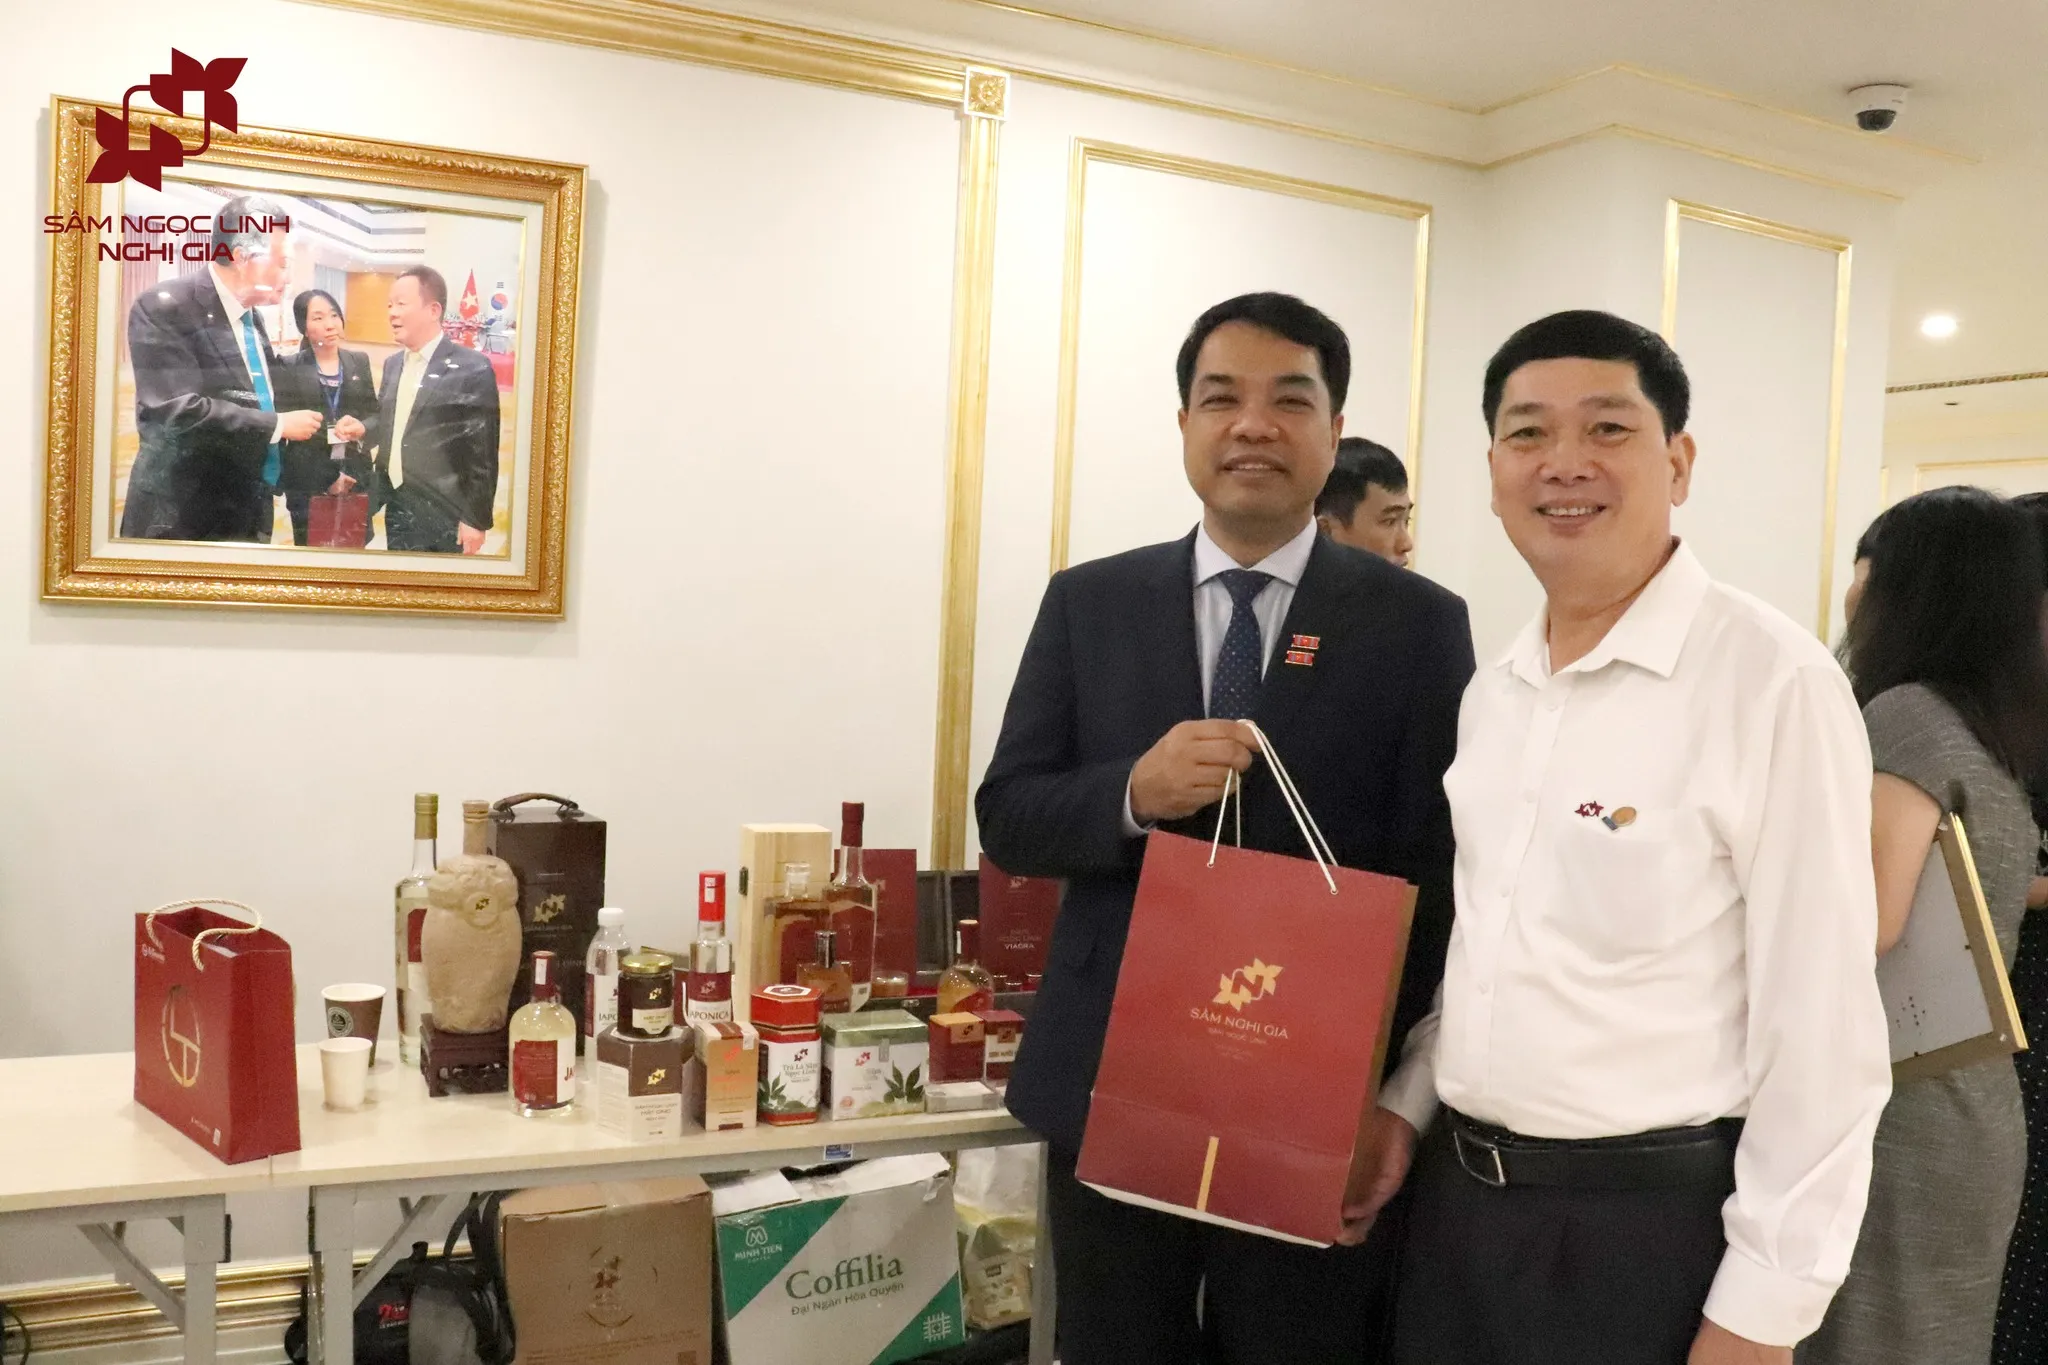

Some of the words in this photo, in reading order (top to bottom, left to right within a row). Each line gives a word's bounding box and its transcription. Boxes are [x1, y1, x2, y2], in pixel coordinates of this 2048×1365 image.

[1190, 1007, 1222, 1024] SÂM
[1224, 1016, 1261, 1034] NGHỊ
[1263, 1024, 1289, 1040] GIA
[733, 1248, 760, 1261] MINH
[785, 1253, 903, 1299] Coffilia
